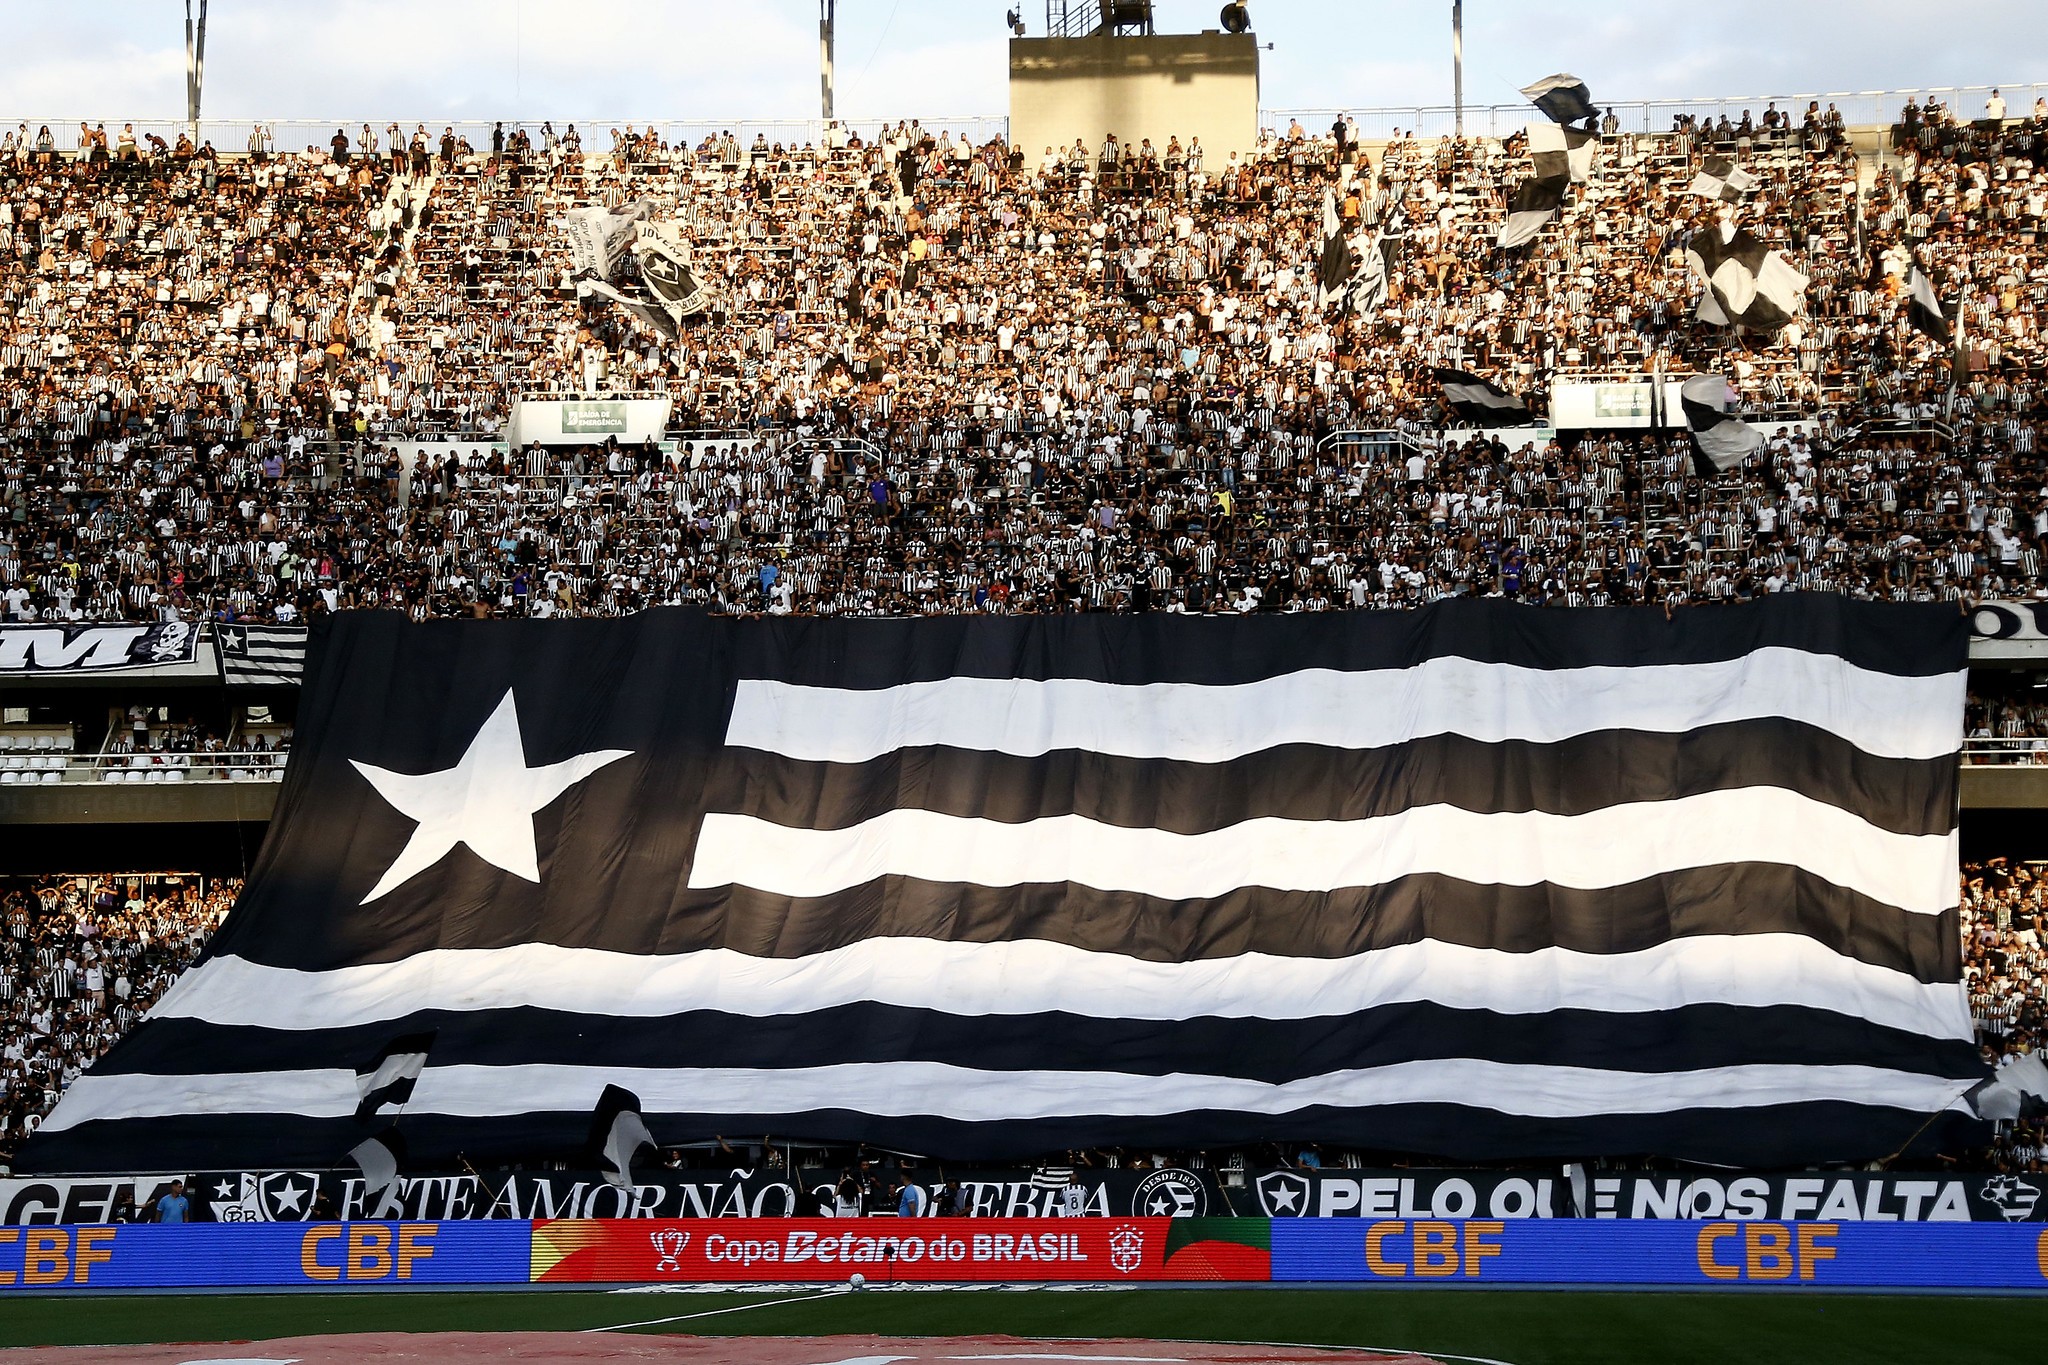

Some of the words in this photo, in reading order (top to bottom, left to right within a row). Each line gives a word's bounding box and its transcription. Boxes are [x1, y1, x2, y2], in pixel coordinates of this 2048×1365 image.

[642, 227, 682, 258] JOVEM
[601, 410, 611, 418] DE
[340, 1174, 480, 1221] ETE
[484, 1174, 667, 1219] AMOR
[679, 1168, 796, 1219] NÃO
[1070, 1196, 1079, 1210] 8
[1142, 1172, 1177, 1193] DESDE
[1319, 1177, 1477, 1218] PELO
[1631, 1177, 1770, 1220] NOS
[1780, 1178, 1972, 1222] FALTA
[301, 1223, 440, 1281] CBF
[705, 1233, 781, 1267] Copa
[783, 1230, 926, 1263] Betano
[927, 1233, 966, 1262] do
[972, 1232, 1088, 1262] BRASIL
[1364, 1220, 1505, 1277] CBF
[1696, 1222, 1840, 1280] CBF
